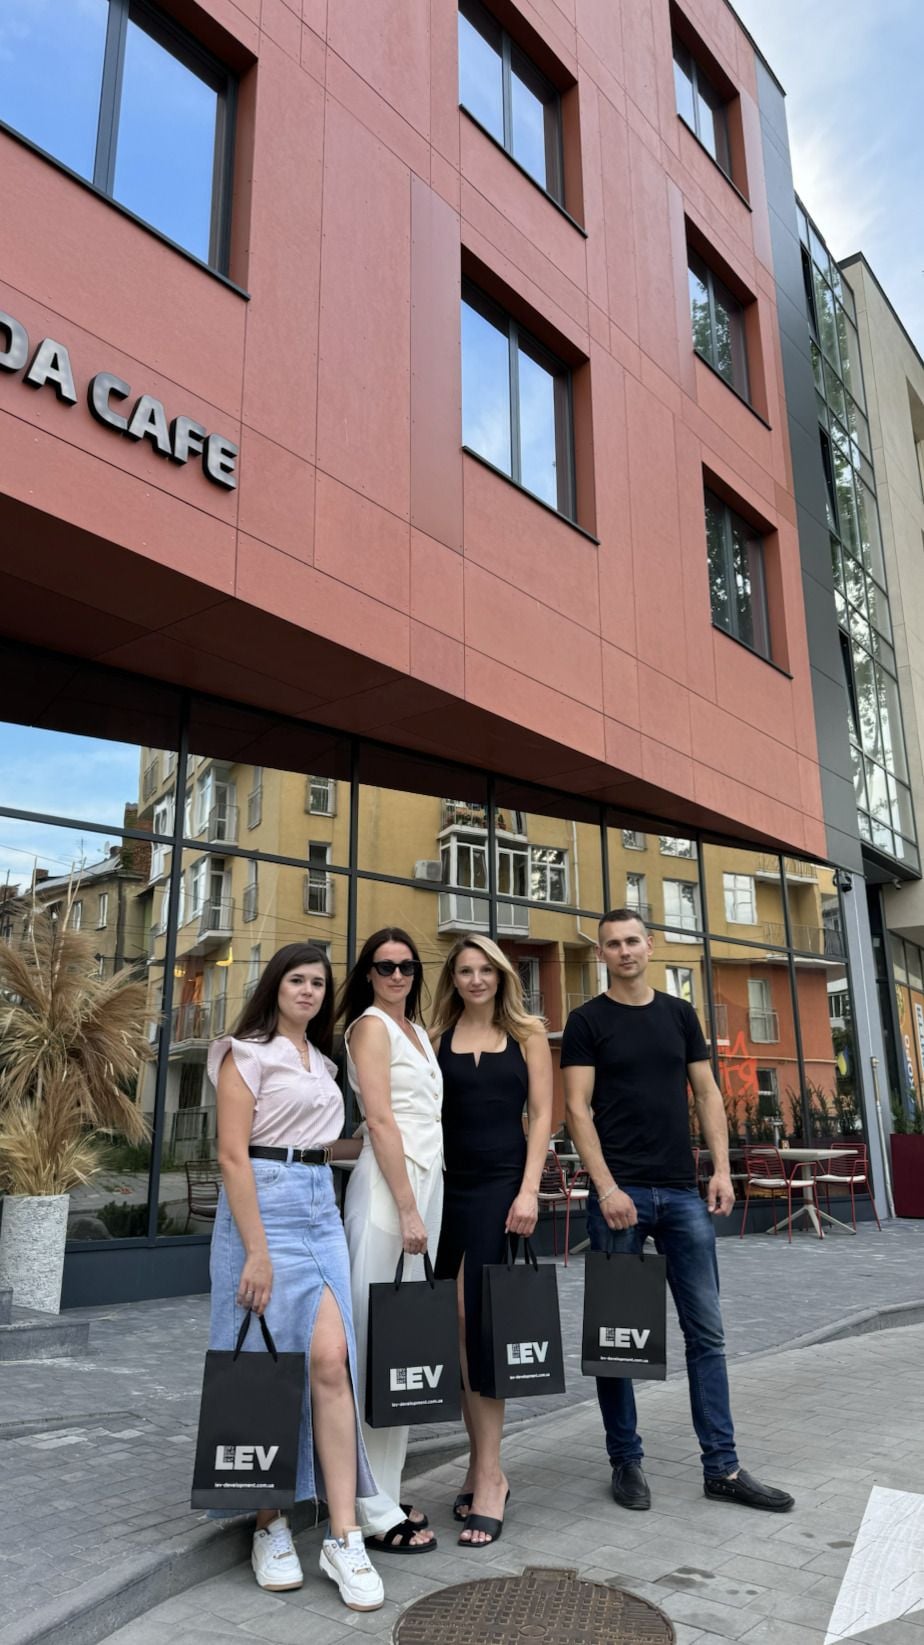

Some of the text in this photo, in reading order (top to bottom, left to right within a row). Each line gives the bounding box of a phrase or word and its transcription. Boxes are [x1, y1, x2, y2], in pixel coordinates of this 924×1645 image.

[87, 371, 239, 491] CAFE
[599, 1326, 651, 1349] LEV
[506, 1341, 549, 1365] LEV
[389, 1364, 444, 1392] LEV
[214, 1445, 280, 1471] LEV
